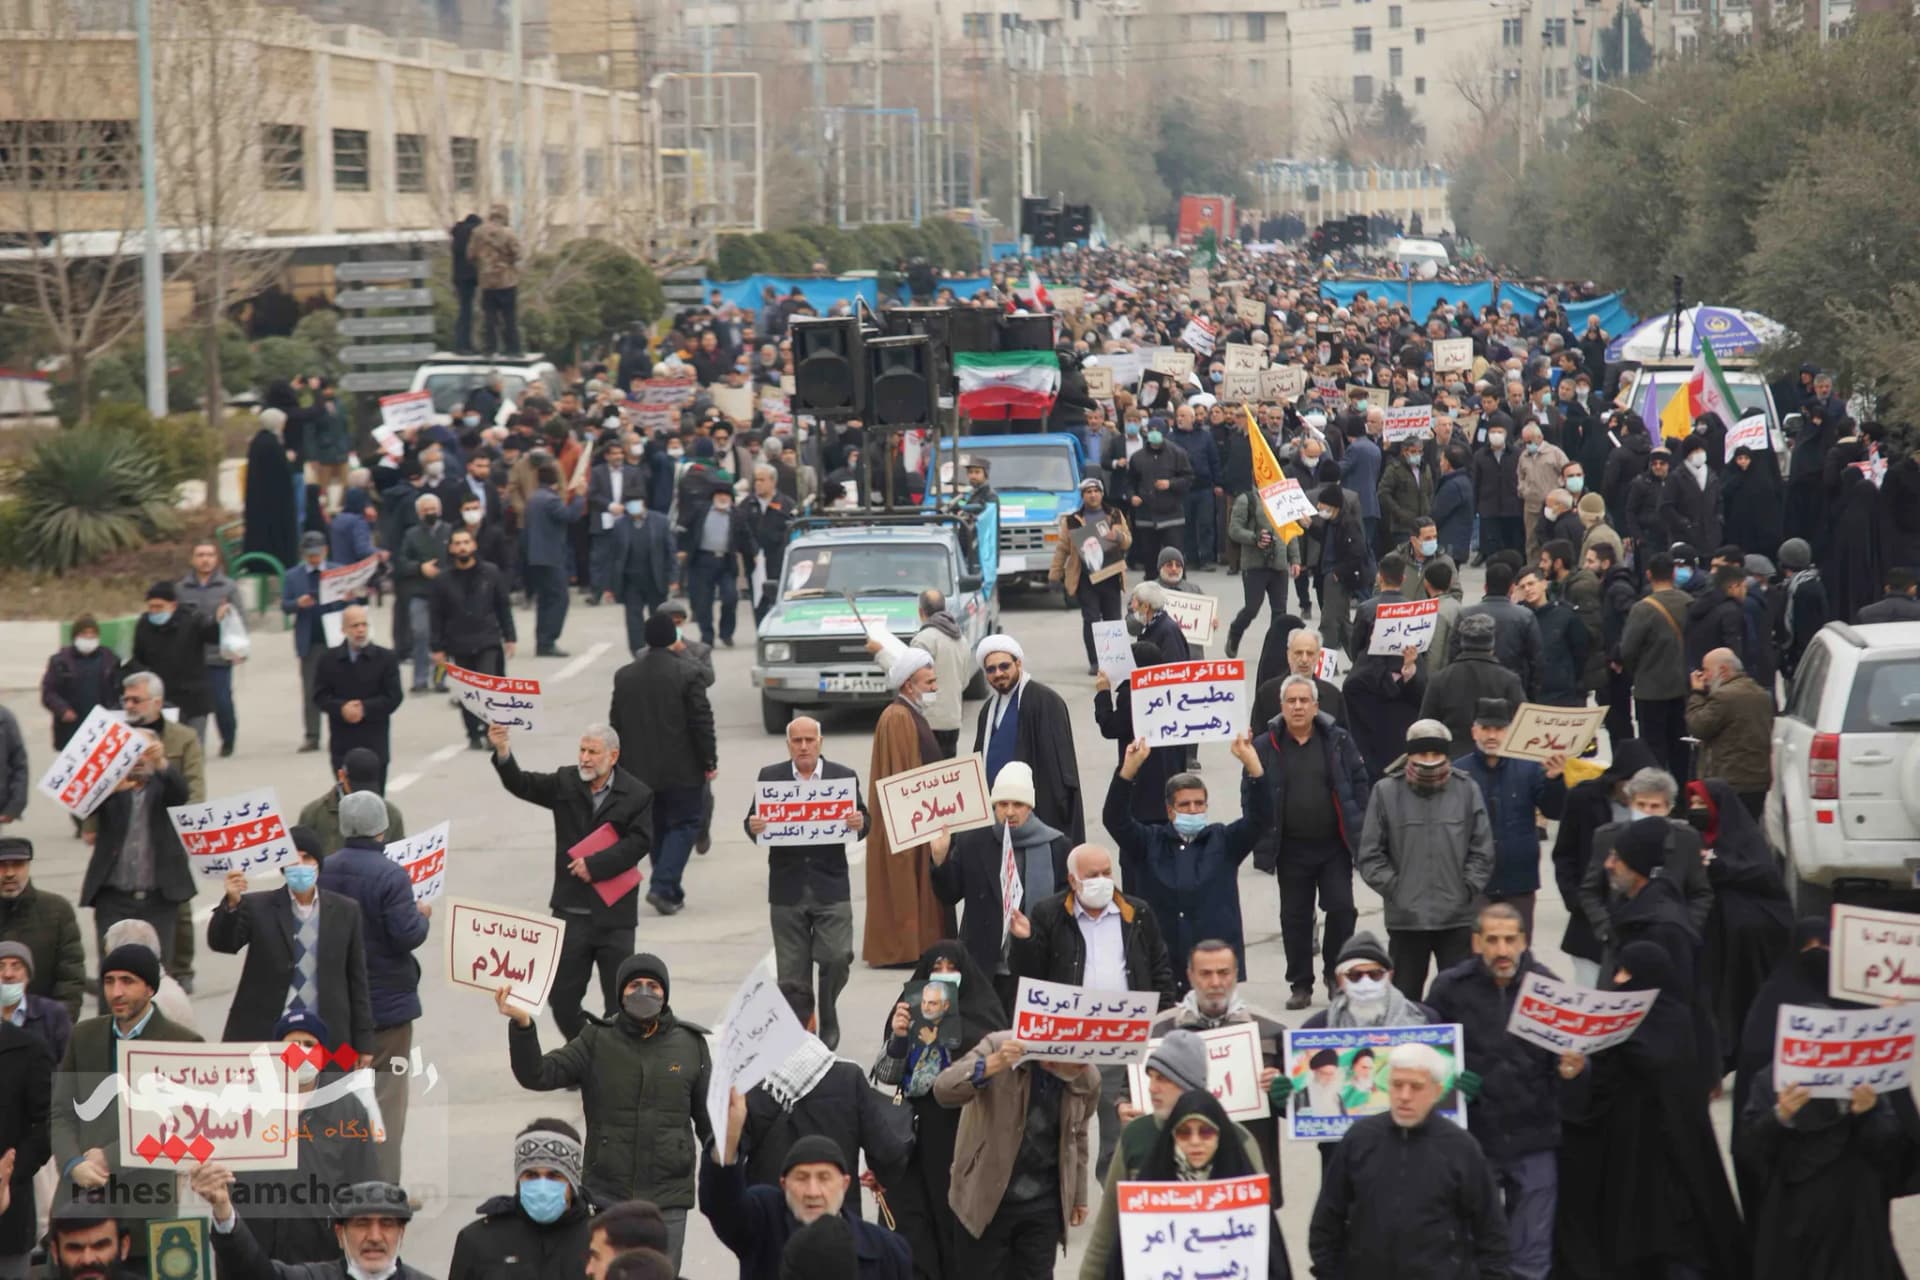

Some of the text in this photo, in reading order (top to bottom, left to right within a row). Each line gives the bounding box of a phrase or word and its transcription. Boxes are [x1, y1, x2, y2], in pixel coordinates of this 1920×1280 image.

[1173, 613, 1199, 631] اسلا
[1136, 663, 1239, 688] ما تا آخر ایستاده ایم
[485, 696, 534, 712] مطیع
[1144, 685, 1235, 716] مطیع امر
[1160, 716, 1231, 739] رهبریم
[1523, 732, 1578, 751] اسلام
[762, 785, 849, 802] مرگ بر آمریکا
[901, 770, 960, 799] کلنا فداک یا
[176, 802, 270, 830] مرگ بر آمریکا
[760, 804, 853, 821] مرگ بر اسرائیل
[911, 791, 964, 834] اسلام
[188, 822, 282, 854] مرگ بر اسرائیل
[762, 824, 851, 840] مرگ بر انگلیس
[202, 847, 288, 875] مرگ بر انگلیس
[472, 918, 542, 945] کلنا فداک یا
[472, 946, 536, 985] اسلام
[1864, 956, 1920, 990] سلام
[1028, 988, 1147, 1018] مرگ بر آمریکا
[1532, 981, 1643, 1014] مرگ بر آمریکا
[1020, 1016, 1147, 1041] مرگ بر اسرائیل
[1519, 1000, 1641, 1036] مرگ بر اسرائیل
[1789, 1015, 1911, 1039] مرگ بر آمریکا
[1517, 1025, 1574, 1047] انگلیس
[1080, 1048, 1094, 1059] بر
[1100, 1046, 1138, 1059] مرگ
[1209, 1043, 1231, 1060] کلنا
[1783, 1040, 1913, 1067] مرگ بر اسرائیل
[170, 1065, 219, 1085] فداک
[1869, 1069, 1904, 1086] مرگ
[158, 1101, 253, 1148] اسلام
[1127, 1182, 1262, 1211] ما تا آخر ایستاده ایم
[1142, 1216, 1256, 1253] مطیع امر
